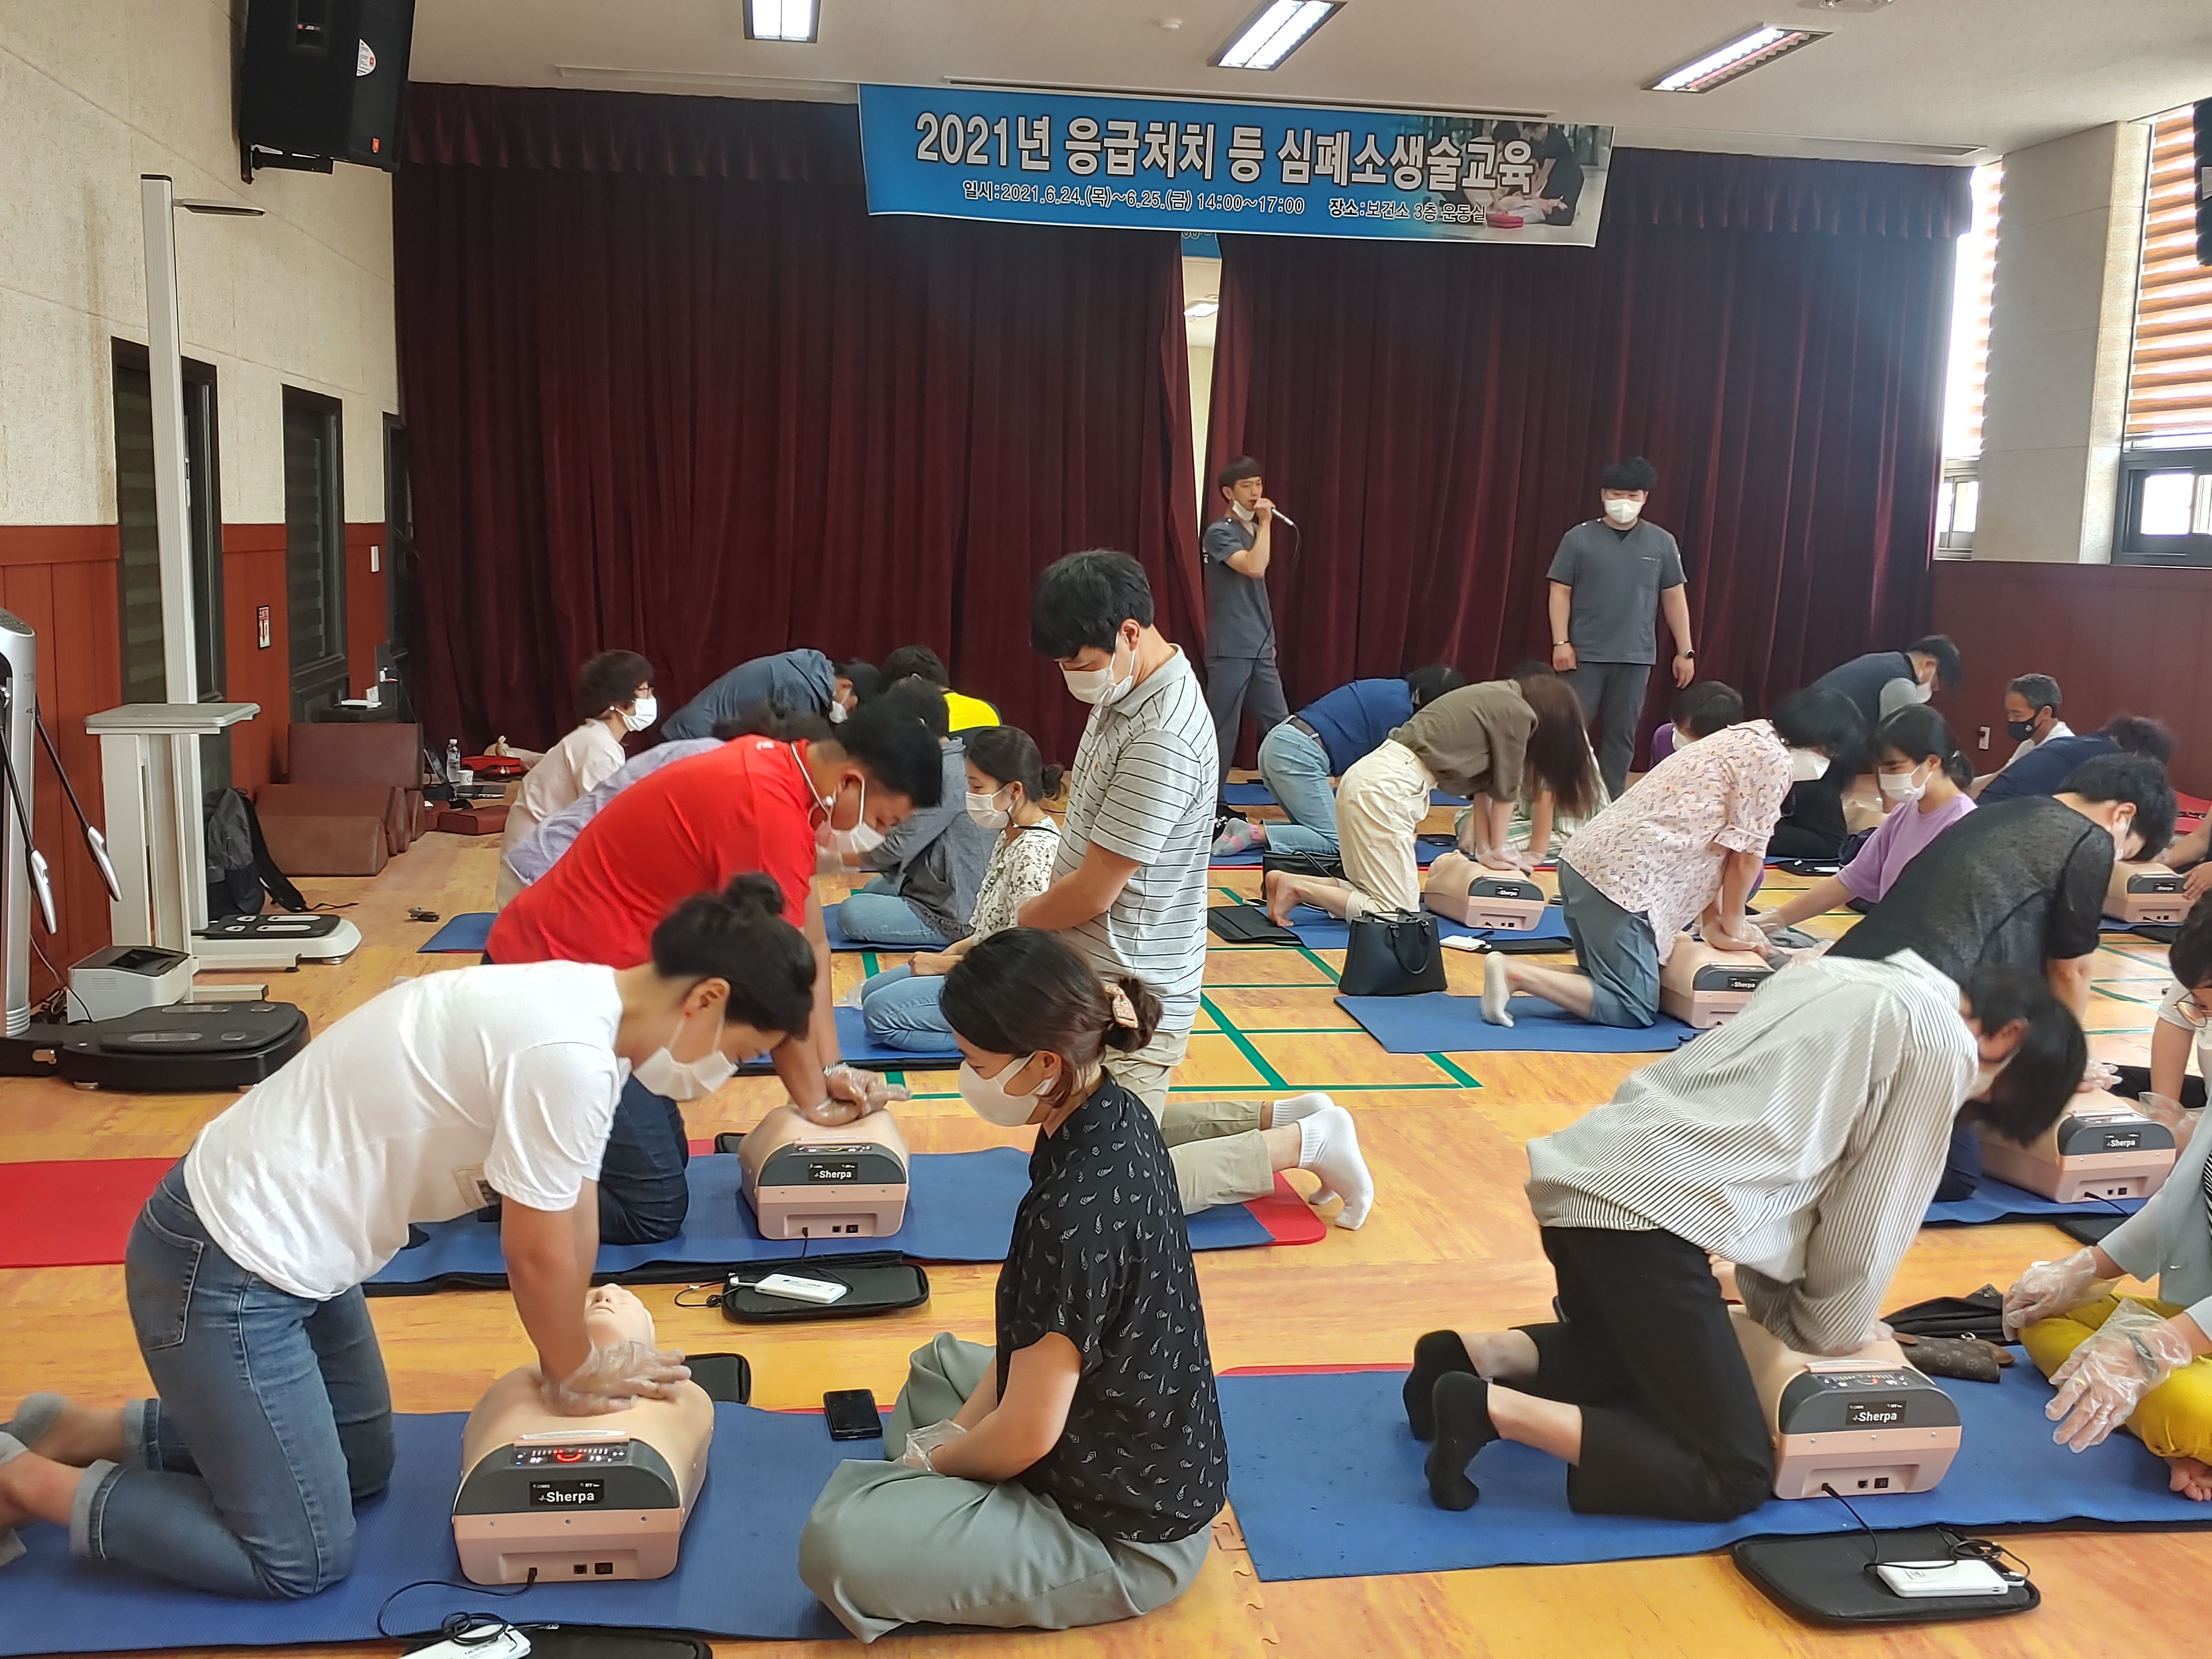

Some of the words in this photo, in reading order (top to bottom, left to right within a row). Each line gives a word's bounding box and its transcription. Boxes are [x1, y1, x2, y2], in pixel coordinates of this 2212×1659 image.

[916, 111, 1050, 171] 2021년
[1064, 116, 1215, 180] 응급처치
[1228, 126, 1265, 183] 등
[1277, 128, 1534, 194] 심폐소생술교육
[1197, 193, 1305, 215] 14:00~17:00
[1329, 198, 1411, 221] 장소:보건소
[1414, 202, 1438, 222] 3층
[1441, 202, 1487, 224] 운동실
[2110, 1139, 2136, 1148] Sherpa
[819, 1170, 852, 1180] Sherpa
[1859, 1411, 1898, 1424] Sherpa
[546, 1491, 595, 1504] Sherpa
